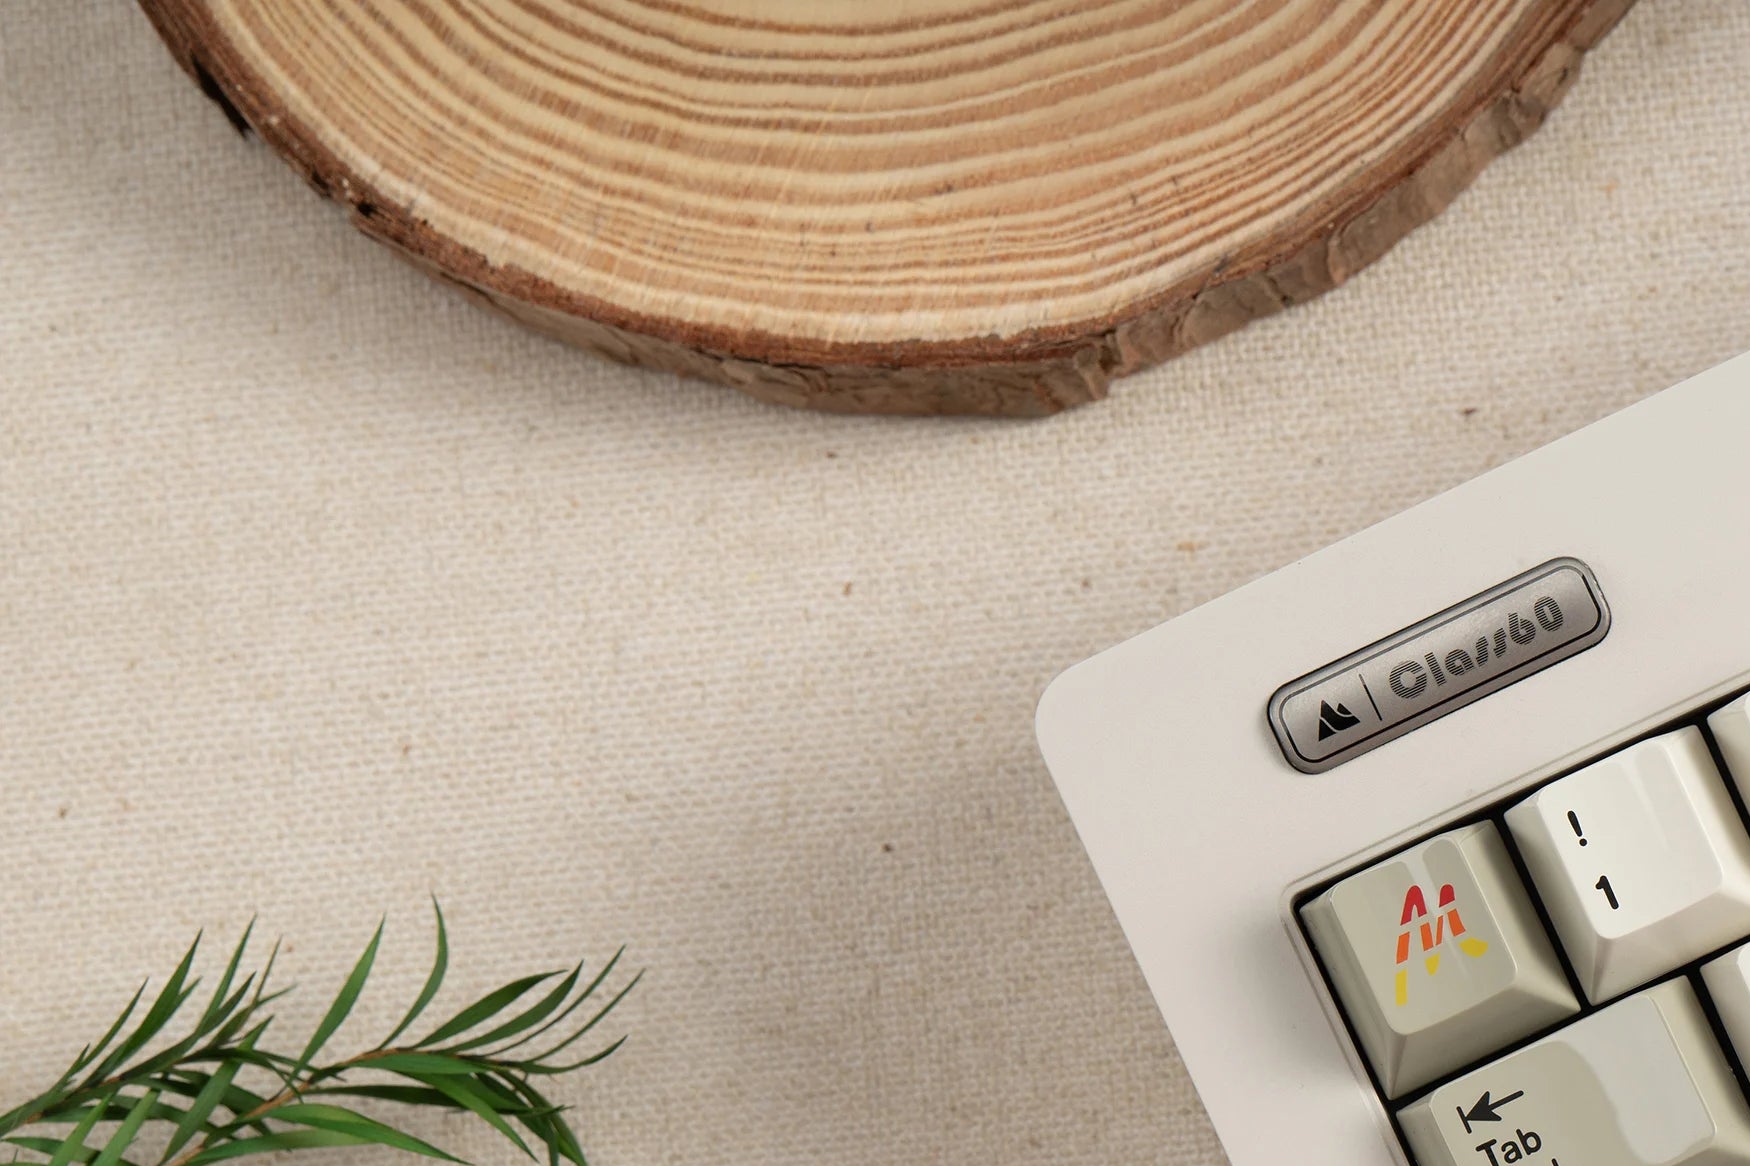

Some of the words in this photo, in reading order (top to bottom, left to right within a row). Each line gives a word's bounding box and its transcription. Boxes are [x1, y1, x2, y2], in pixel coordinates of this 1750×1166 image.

[1388, 595, 1565, 700] Class60
[1567, 810, 1588, 847] !
[1595, 875, 1620, 910] 1
